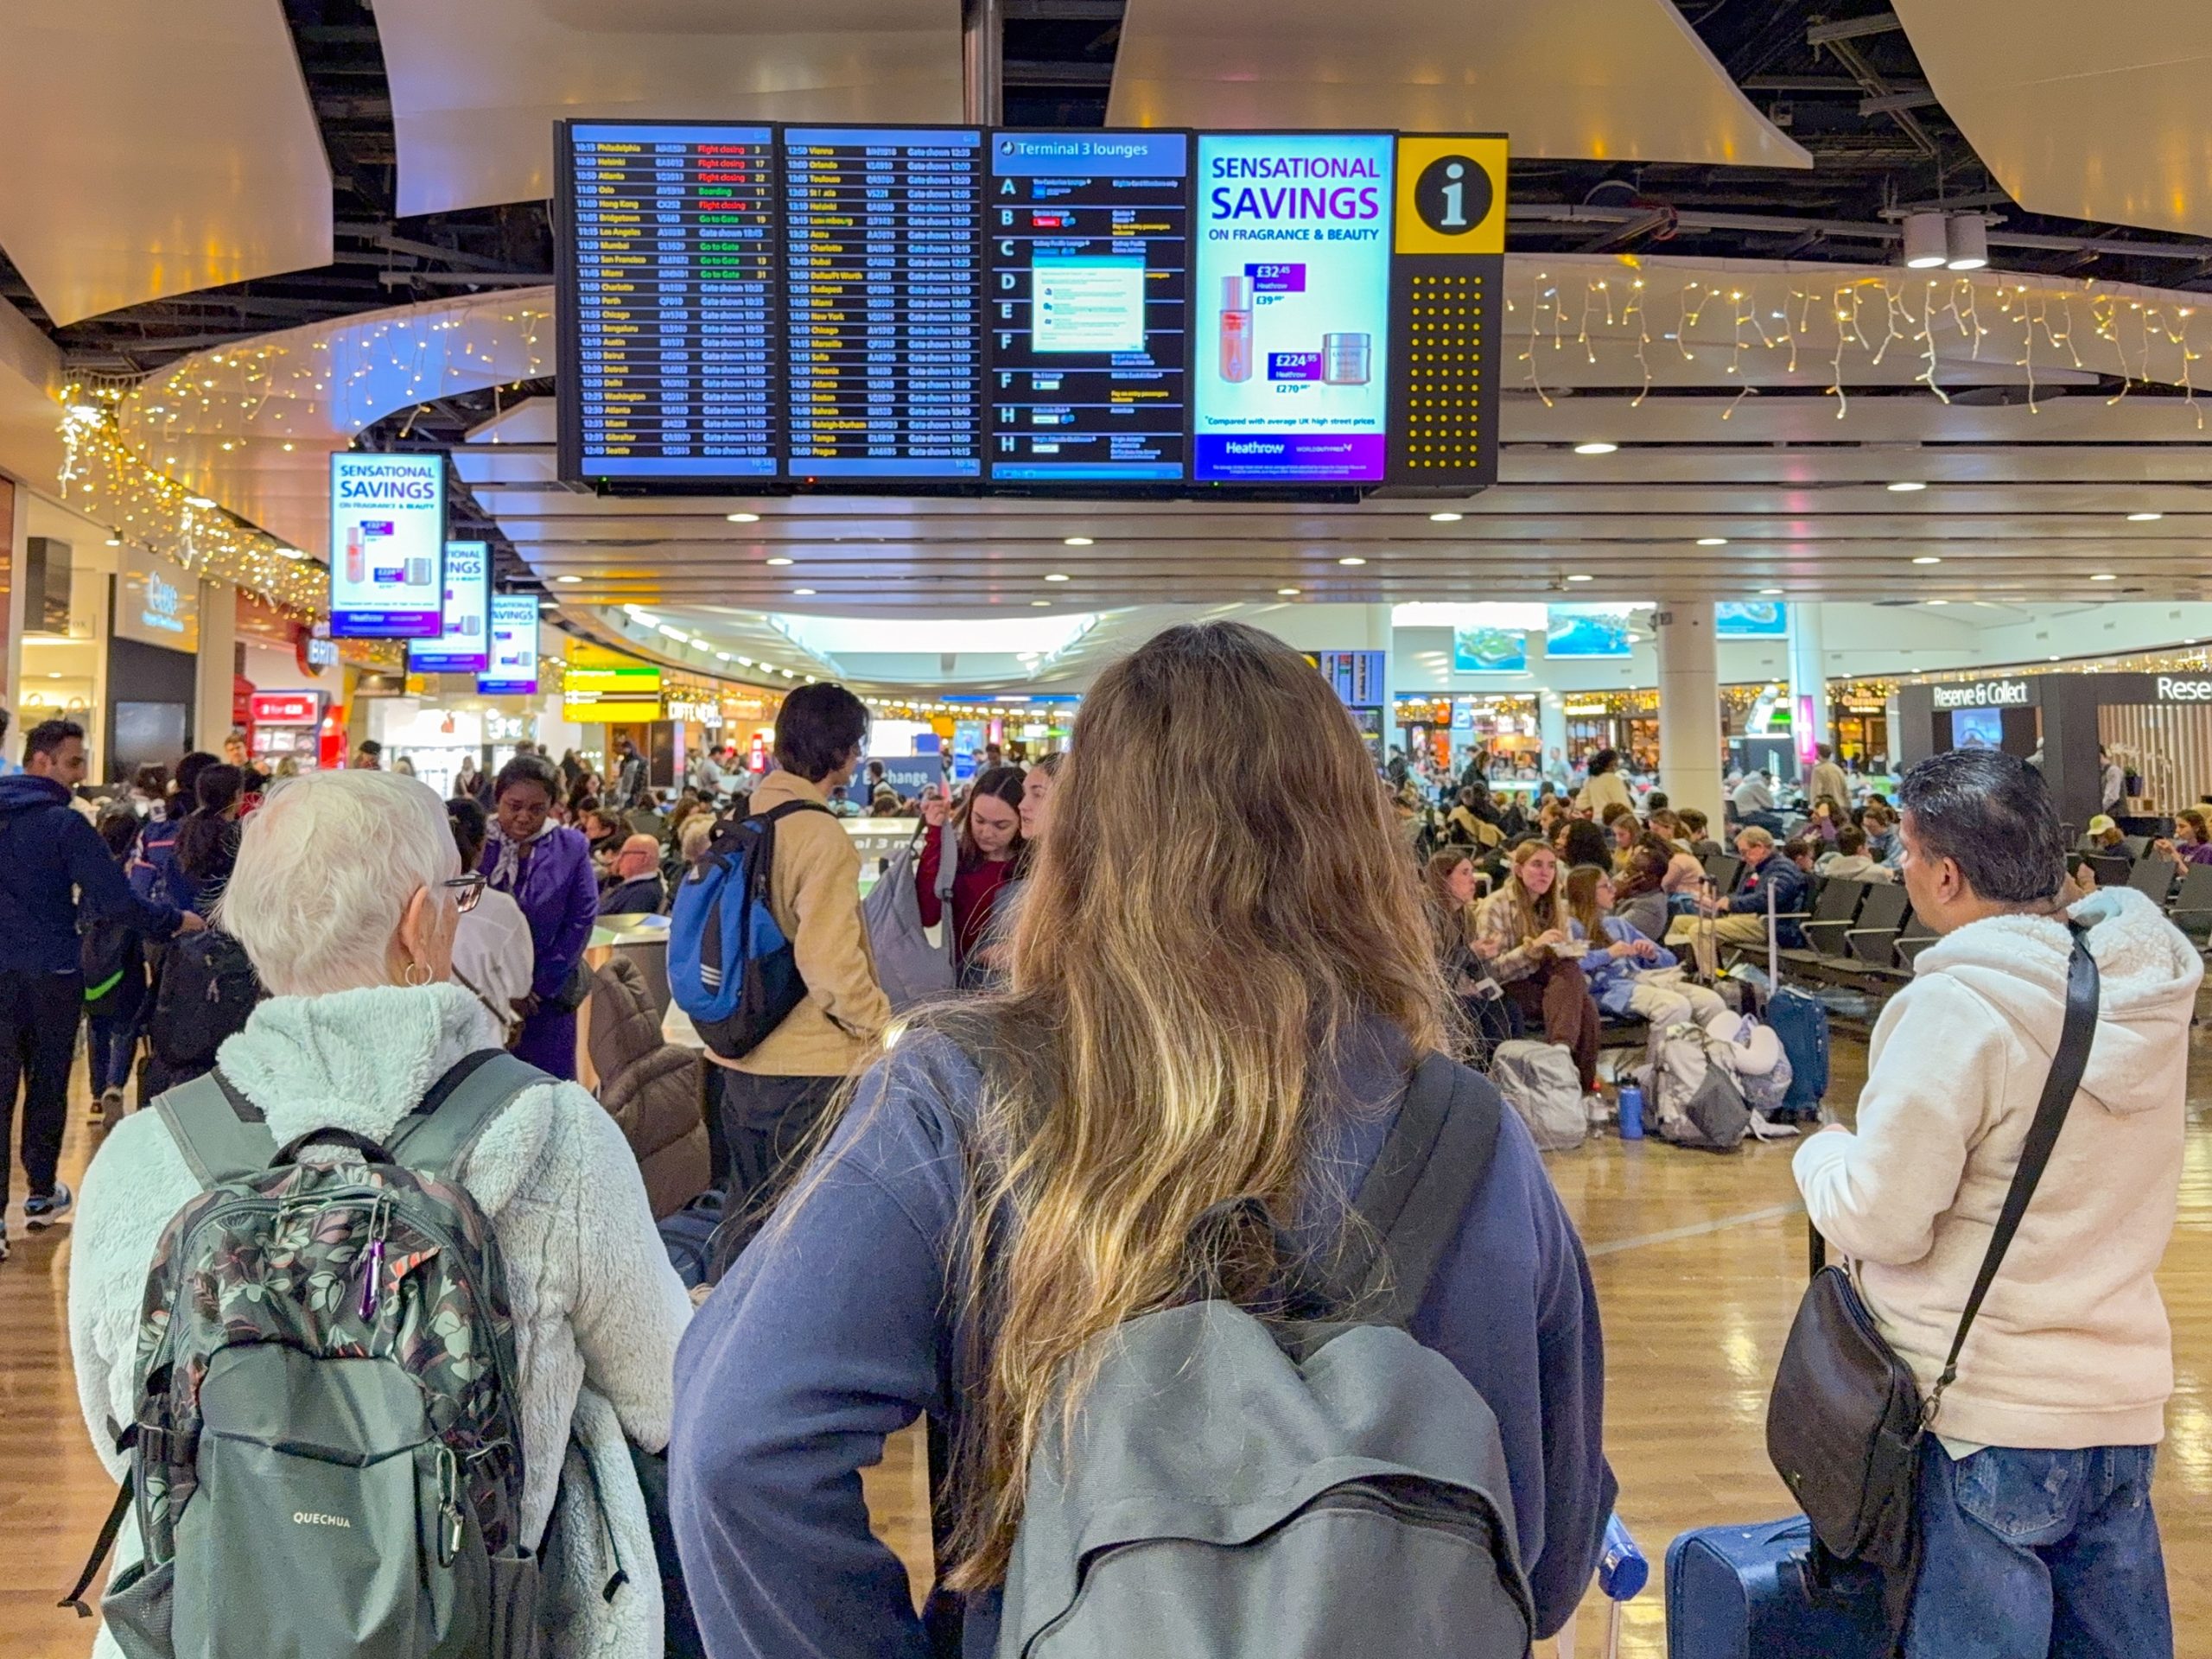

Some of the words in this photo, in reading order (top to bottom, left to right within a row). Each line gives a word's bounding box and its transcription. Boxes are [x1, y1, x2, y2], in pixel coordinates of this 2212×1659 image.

[698, 144, 719, 155] Flight
[720, 145, 746, 155] closing
[1019, 143, 1078, 156] Terminal
[1082, 143, 1090, 156] 3
[1093, 142, 1148, 158] lounges
[698, 158, 719, 168] Flight
[720, 159, 746, 168] closing
[1211, 157, 1380, 179] SENSATIONAL
[698, 172, 719, 182] Flight
[720, 173, 746, 182] closing
[697, 187, 733, 197] Boarding
[1001, 178, 1016, 195] A
[699, 200, 720, 210] Flight
[721, 201, 747, 210] closing
[1211, 187, 1379, 220] SAVINGS
[699, 214, 709, 224] Go
[711, 214, 720, 224] to
[721, 214, 740, 224] Gate
[1001, 209, 1014, 226] B
[1209, 228, 1229, 241] ON
[1233, 228, 1310, 241] FRAGRANCE
[1313, 228, 1324, 241] &
[1327, 228, 1379, 241] BEAUTY
[700, 242, 710, 251] Go
[712, 242, 721, 251] to
[721, 242, 740, 251] Gate
[1001, 240, 1014, 257] C
[700, 256, 710, 265] Go
[712, 256, 721, 265] to
[721, 256, 741, 265] Gate
[757, 257, 767, 265] 13
[701, 270, 711, 279] Go
[713, 270, 721, 279] to
[722, 270, 741, 279] Gate
[1001, 273, 1015, 289] D
[1001, 302, 1013, 319] E
[1001, 334, 1012, 350] F
[1001, 372, 1012, 389] F
[1275, 371, 1307, 379] Heathrow
[1001, 407, 1015, 423] H
[1268, 418, 1297, 427] average
[1312, 417, 1328, 427] high
[1001, 435, 1015, 452] H
[1225, 442, 1286, 454] Heathrow
[340, 465, 435, 479] SENSATIONAL
[340, 480, 435, 499] SAVINGS
[1933, 686, 1975, 708] Reserve
[1975, 683, 1987, 705] &
[1987, 680, 2027, 705] Collect
[2158, 677, 2212, 701] Rese
[862, 768, 928, 788] Ehange
[293, 1511, 351, 1529] QUECHUA
